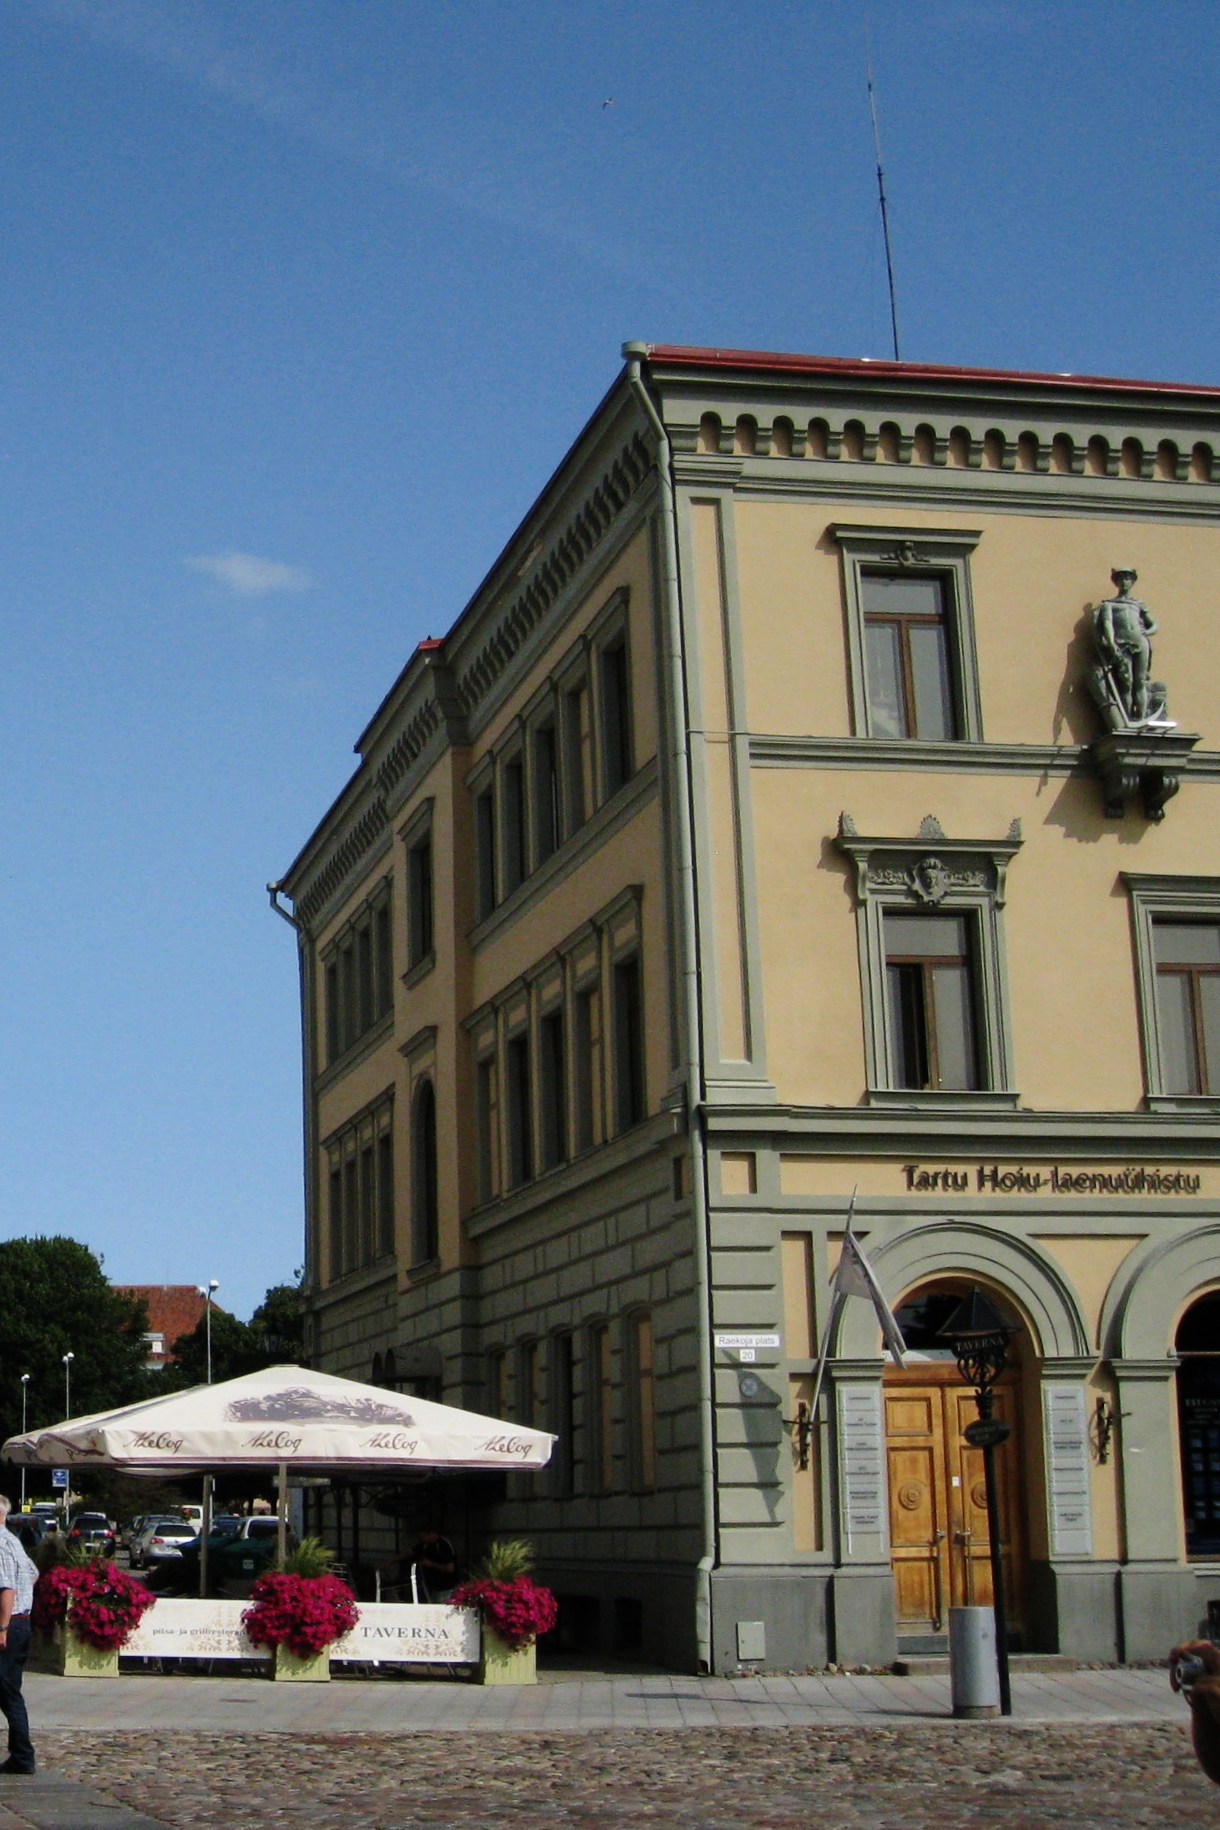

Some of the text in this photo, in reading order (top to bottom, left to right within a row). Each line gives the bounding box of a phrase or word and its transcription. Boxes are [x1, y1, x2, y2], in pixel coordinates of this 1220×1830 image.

[902, 1165, 1201, 1194] Tartu Hoiu-laenuühistu
[719, 1337, 775, 1347] Raekoja plats
[955, 1336, 1004, 1352] TAVERNA
[742, 1351, 753, 1359] 20
[360, 1626, 449, 1639] TAVERNA
